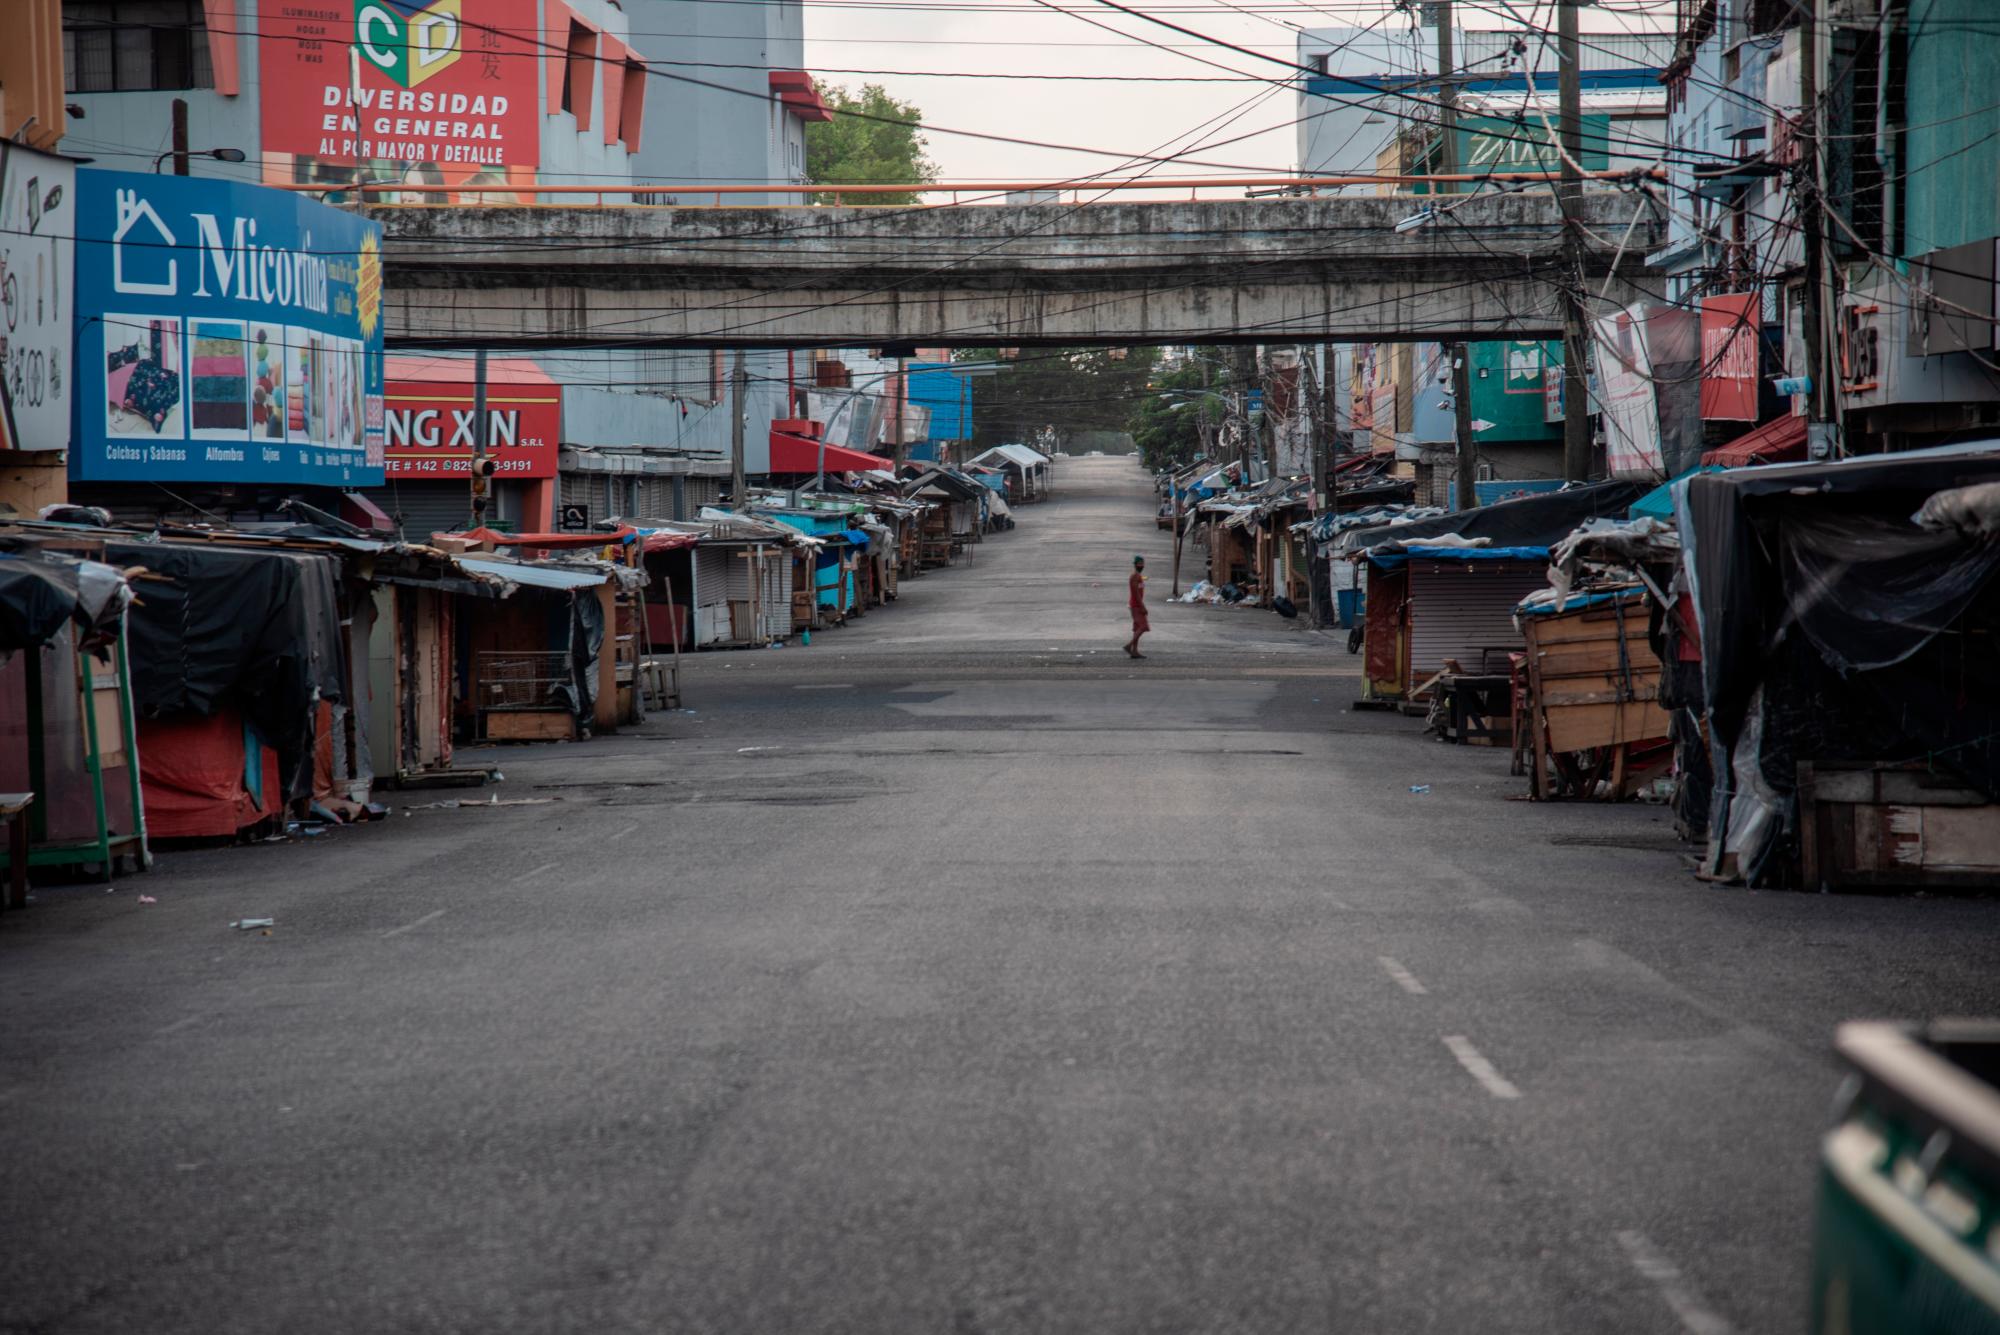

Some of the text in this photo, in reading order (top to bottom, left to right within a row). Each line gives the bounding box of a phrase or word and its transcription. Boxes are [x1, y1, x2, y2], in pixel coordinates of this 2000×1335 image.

[297, 25, 326, 35] HOGAR
[323, 86, 508, 116] DIVERSIDAD
[322, 114, 503, 140] EN GENERAL
[319, 138, 337, 155] AL
[377, 141, 424, 161] MAYOR
[431, 144, 439, 161] Y
[445, 144, 503, 164] DETALLE
[190, 213, 328, 314] Micortina
[449, 410, 517, 447] XN
[106, 445, 186, 463] Colchas y Sabanas
[415, 460, 437, 471] 142
